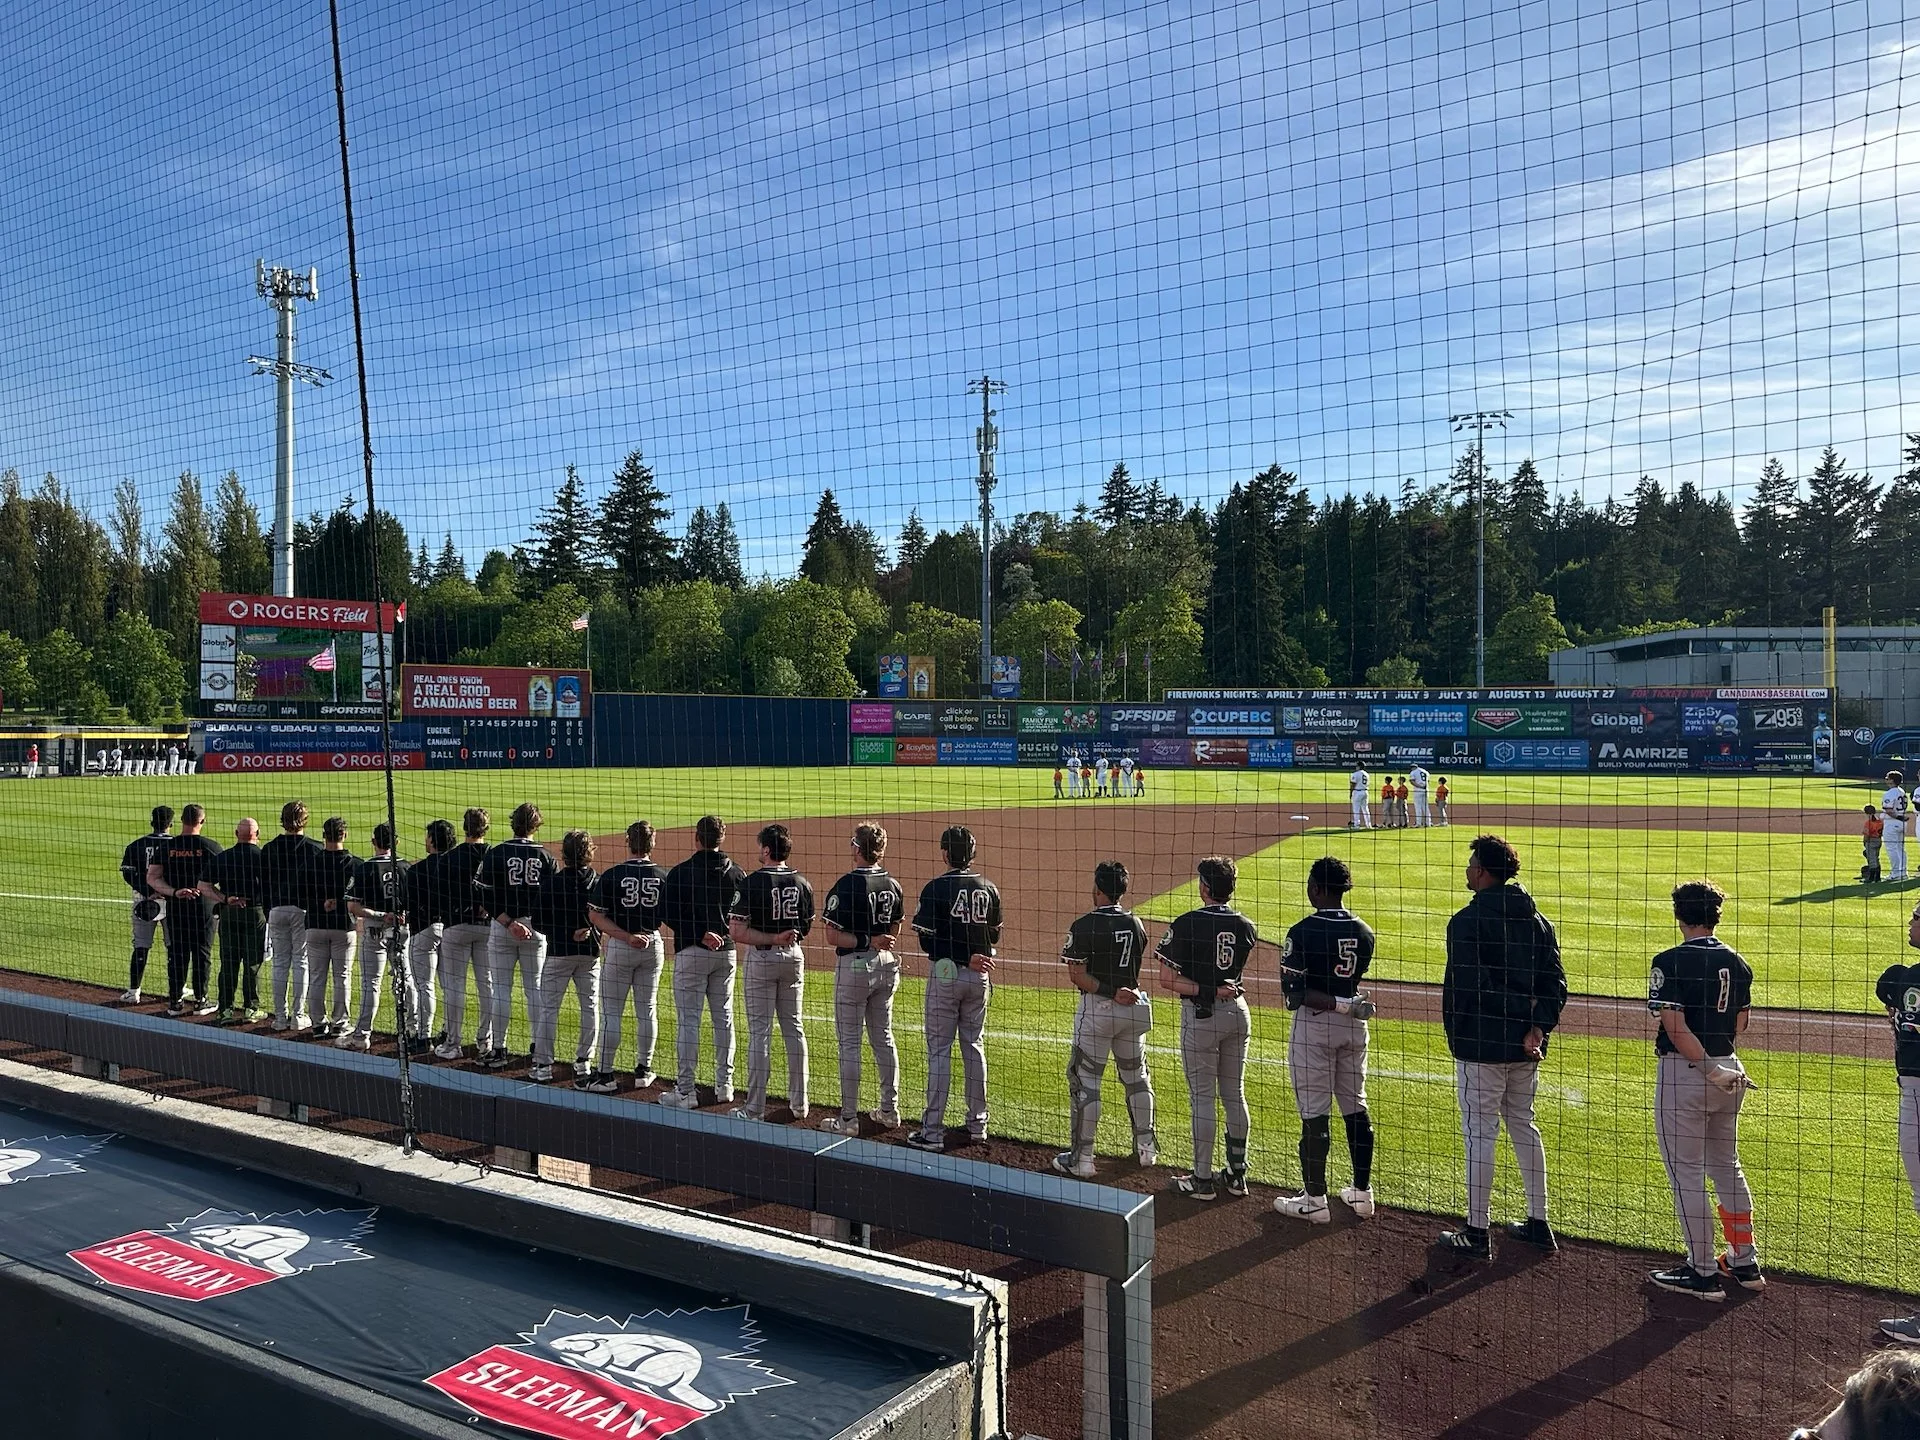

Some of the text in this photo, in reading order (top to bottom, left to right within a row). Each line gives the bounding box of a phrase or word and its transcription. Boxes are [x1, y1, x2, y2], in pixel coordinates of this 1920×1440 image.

[254, 603, 368, 623] ROGERS Field
[414, 675, 482, 684] REAL ONES KNOW
[414, 685, 490, 697] A REAL GOOD
[1167, 691, 1220, 699] FIREWORKS
[1223, 691, 1260, 699] NIGHTS:
[1266, 691, 1294, 699] APRIL
[1297, 691, 1303, 699] 7
[1311, 691, 1336, 699] JUNE
[1354, 691, 1379, 699] JULY
[1382, 691, 1386, 699] 1
[1395, 691, 1418, 699] JULY
[1423, 691, 1429, 699] 9
[1438, 691, 1463, 699] JULY
[1467, 691, 1478, 699] 30
[1488, 691, 1531, 699] AUGUST
[1534, 691, 1545, 699] 13
[1555, 690, 1599, 698] AUGUST
[1602, 690, 1615, 698] 27
[1631, 689, 1649, 697] FOR
[1652, 689, 1688, 697] TICKETS
[1719, 689, 1826, 699] CANADIANSBASEBALL.COM
[214, 703, 267, 713] SN650
[414, 697, 517, 710] CANADIANS BEER
[281, 706, 298, 715] MPH
[321, 706, 392, 714] SPORTSNE
[1112, 710, 1176, 721] OFFSIDE
[1304, 708, 1342, 717] We Care
[1373, 709, 1464, 722] The Province
[1207, 711, 1271, 722] CUPE BC
[1590, 713, 1643, 726] Global
[206, 724, 253, 732] SUBARU
[270, 724, 317, 732] SUBARU
[1304, 718, 1360, 728] Wednesday
[1856, 731, 1870, 741] 42
[225, 740, 254, 750] Tantalus
[394, 740, 422, 750] Tantalus
[907, 744, 936, 752] EasyPark
[460, 748, 468, 760] 0
[508, 748, 516, 760] 0
[546, 748, 554, 759] 0
[1388, 746, 1434, 756] Kirmac
[1522, 746, 1580, 756] EDGE
[1623, 748, 1688, 759] AMRIZE
[242, 755, 303, 768] ROGERS
[507, 857, 543, 886] 26
[621, 877, 660, 908] 35
[771, 886, 800, 920] 12
[868, 890, 896, 926] 13
[950, 889, 990, 924] 40
[1114, 930, 1134, 968] 7
[1215, 931, 1236, 970] 6
[1334, 938, 1358, 978] 5
[1717, 968, 1730, 1013] 1
[94, 1240, 246, 1292] SLEEMAN
[457, 1362, 667, 1436] SLEEMAN
